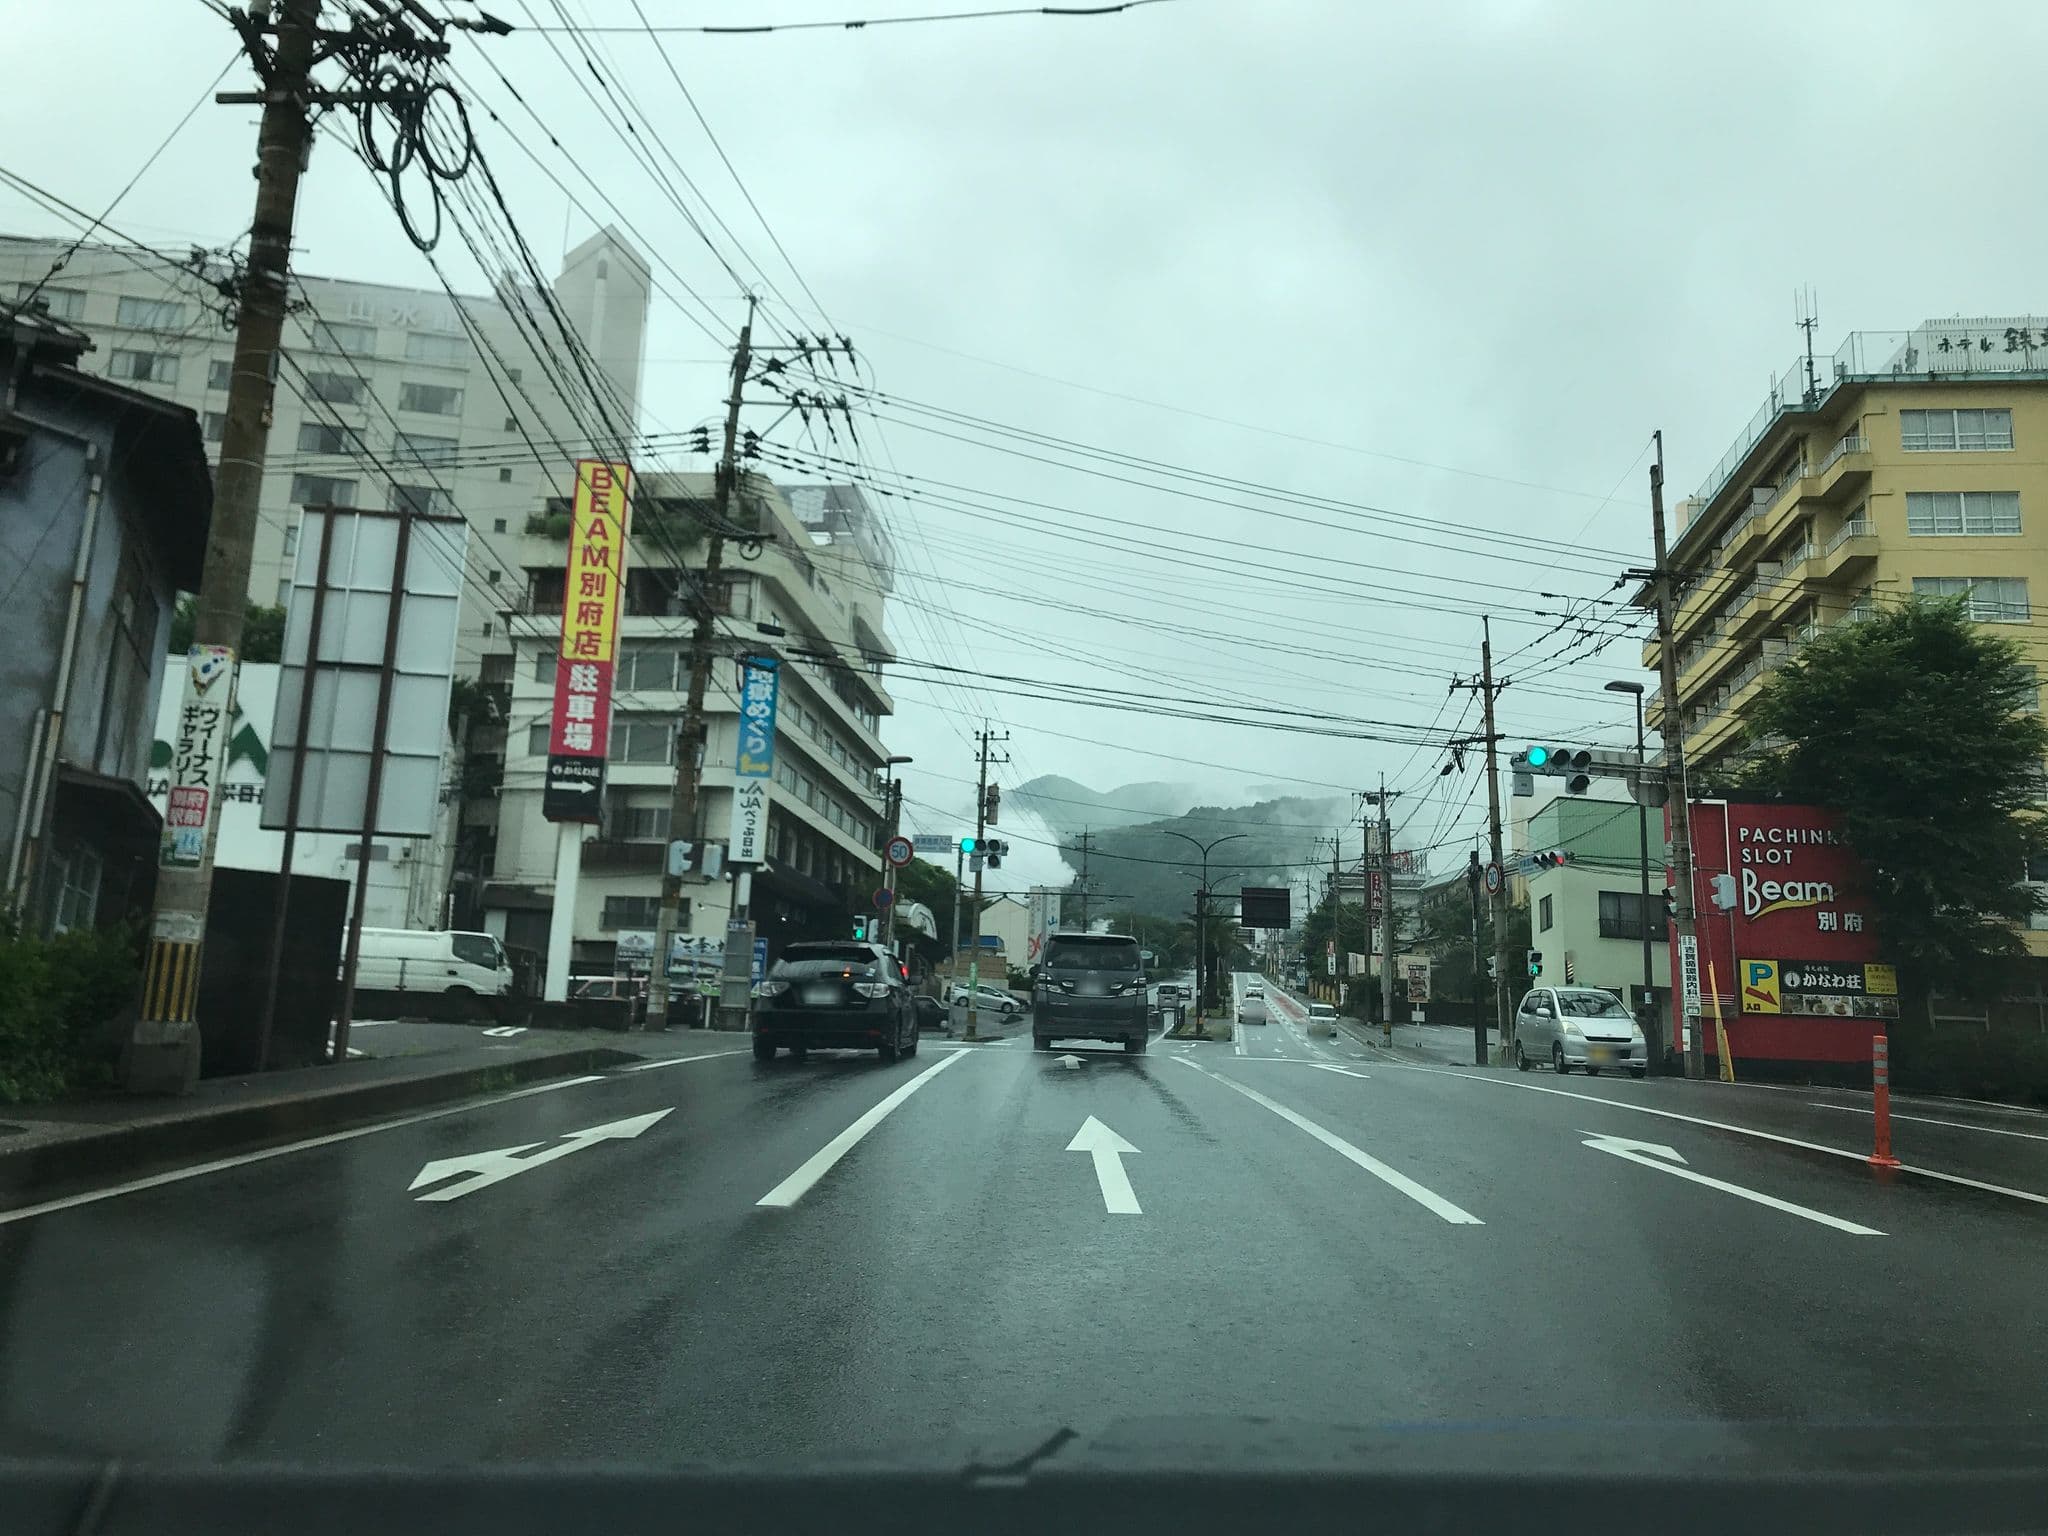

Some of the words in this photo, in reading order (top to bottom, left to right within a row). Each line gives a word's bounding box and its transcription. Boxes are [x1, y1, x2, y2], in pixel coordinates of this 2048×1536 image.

[574, 467, 612, 656] BEAM別府店
[563, 664, 599, 751] 駐車場
[891, 844, 908, 859] 50
[1742, 848, 1793, 864] SLOT
[1742, 867, 1834, 916] Beam
[1818, 911, 1863, 932] 別府
[1750, 963, 1773, 986] P
[1802, 973, 1862, 990] かなわ荘
[1746, 1002, 1761, 1012] 入口
